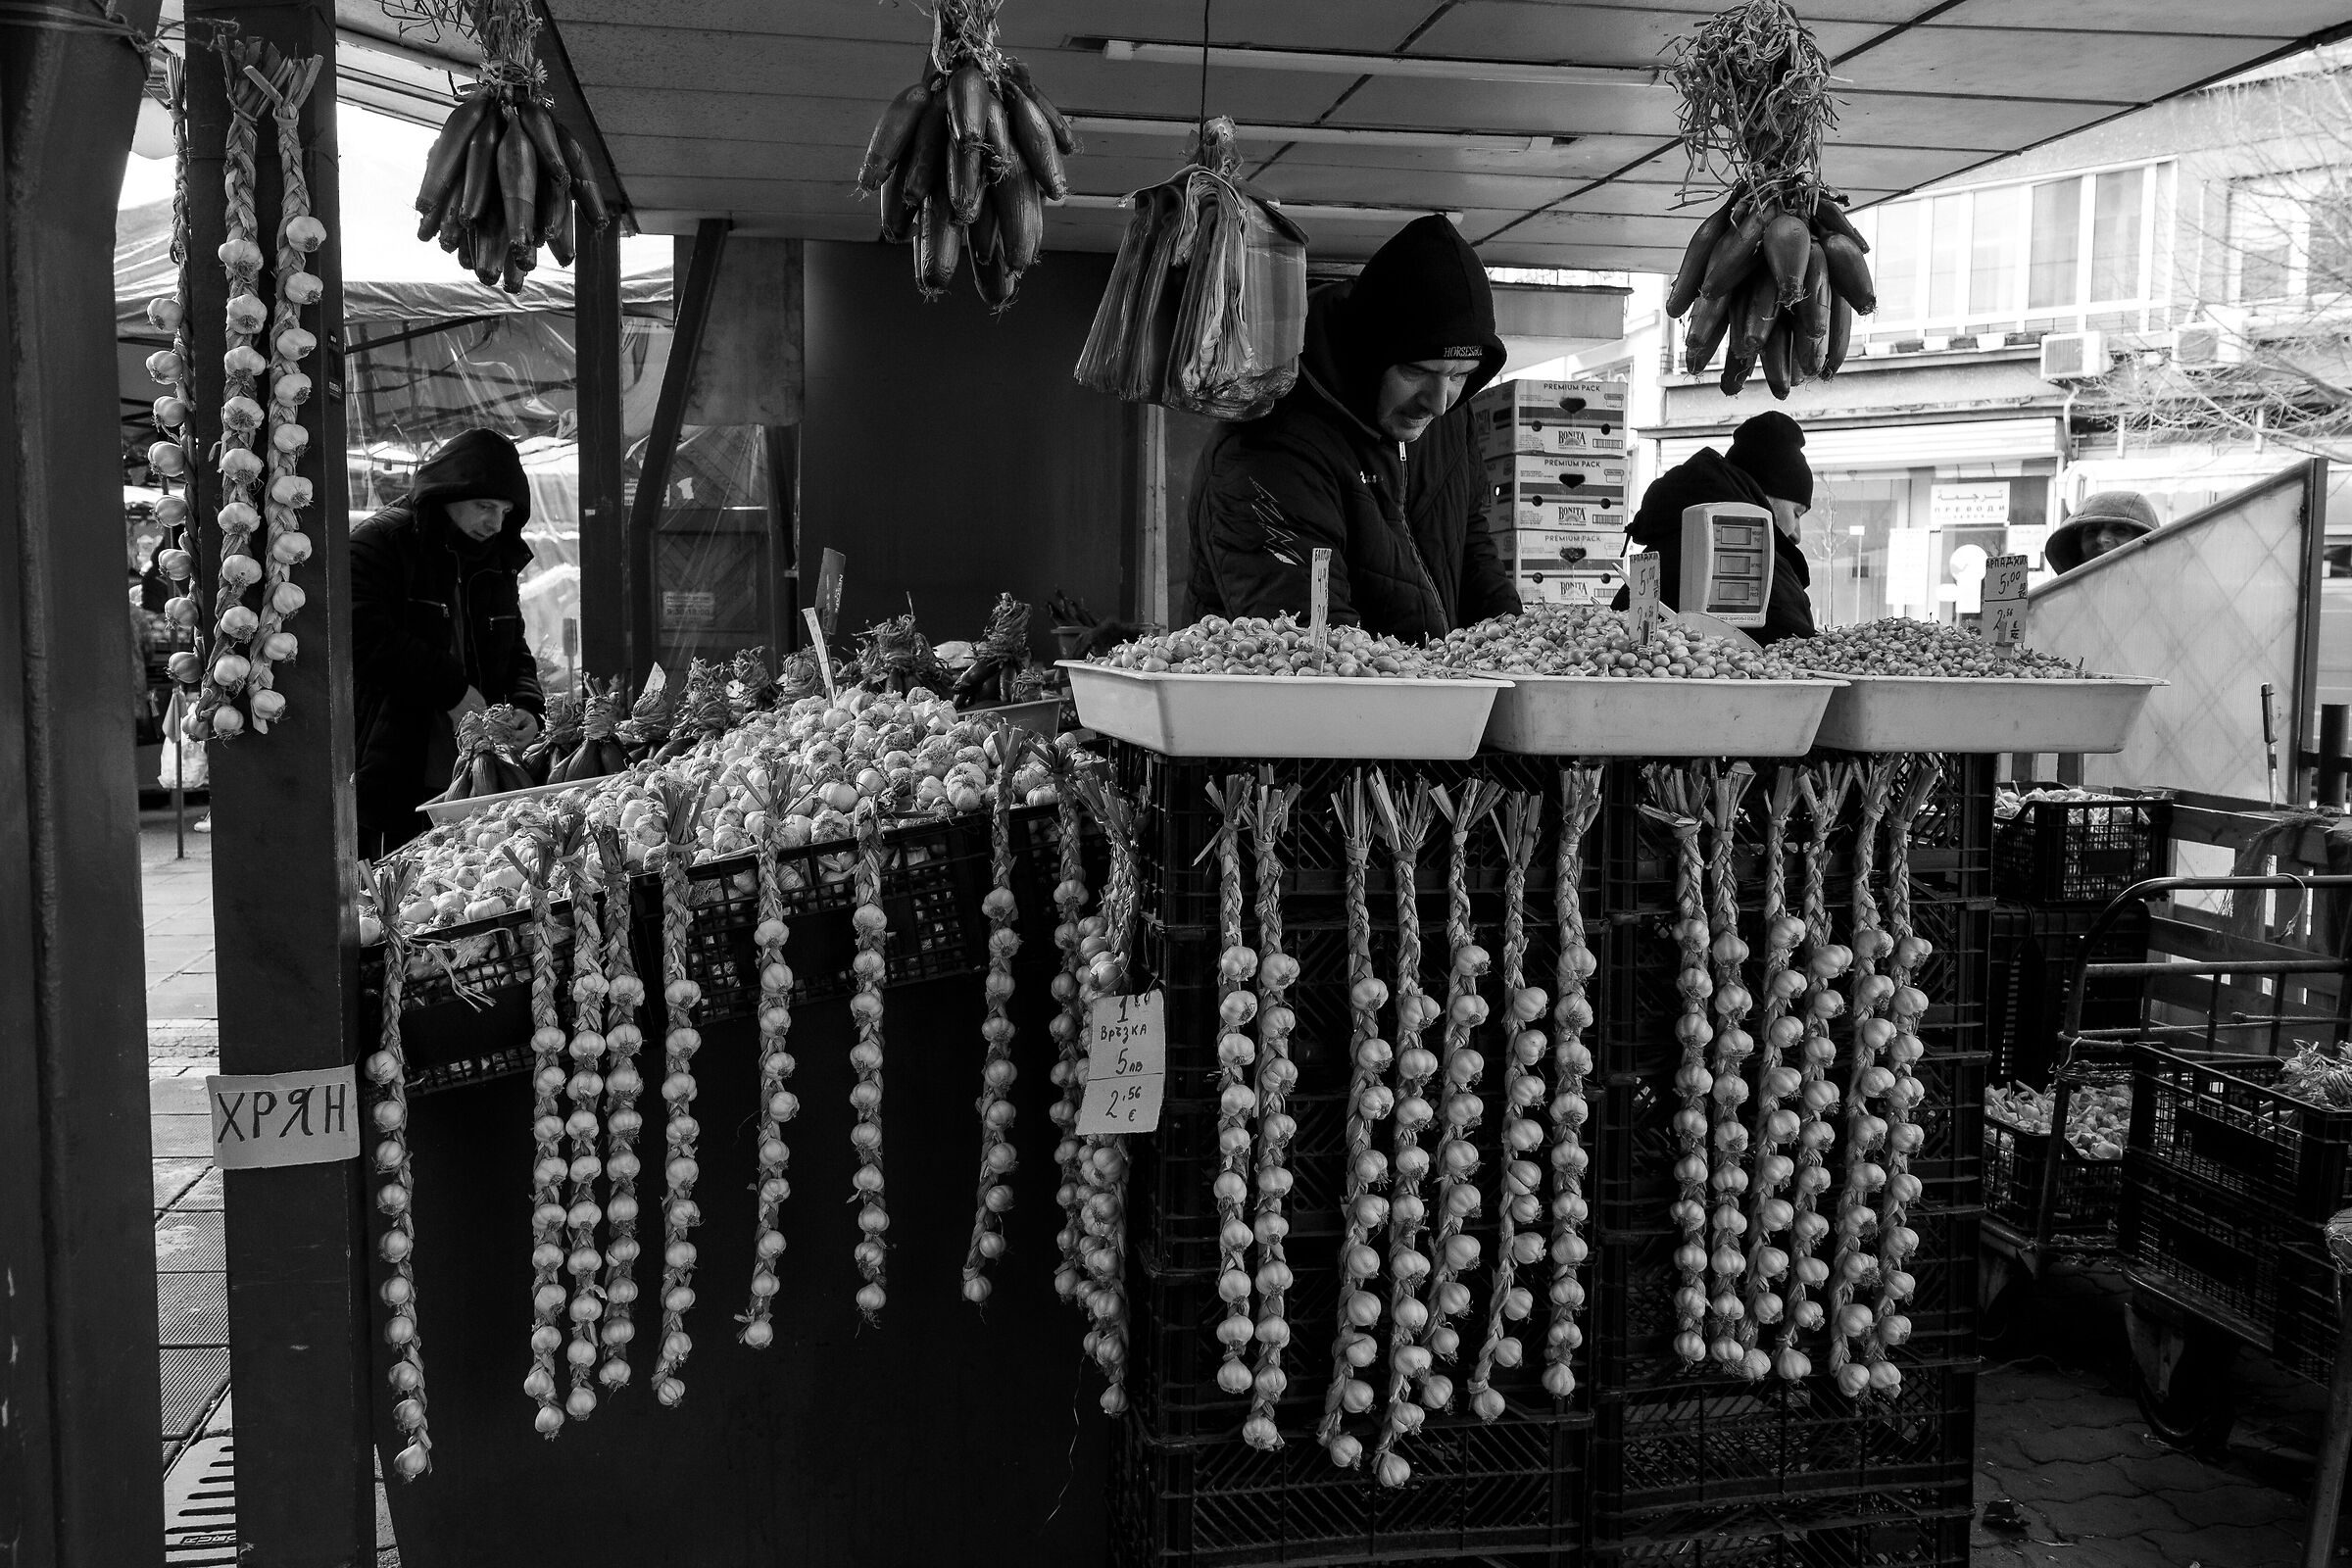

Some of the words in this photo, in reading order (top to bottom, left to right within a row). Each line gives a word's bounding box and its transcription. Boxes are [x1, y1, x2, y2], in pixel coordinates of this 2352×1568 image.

[1558, 430, 1586, 445] BONITA
[1558, 507, 1586, 520] BONITA
[1560, 582, 1588, 596] BONITA
[1998, 571, 2021, 595] 5,00
[1116, 995, 1128, 1023] 1
[1115, 1048, 1128, 1075] 5
[218, 1083, 346, 1144] ХРЯН
